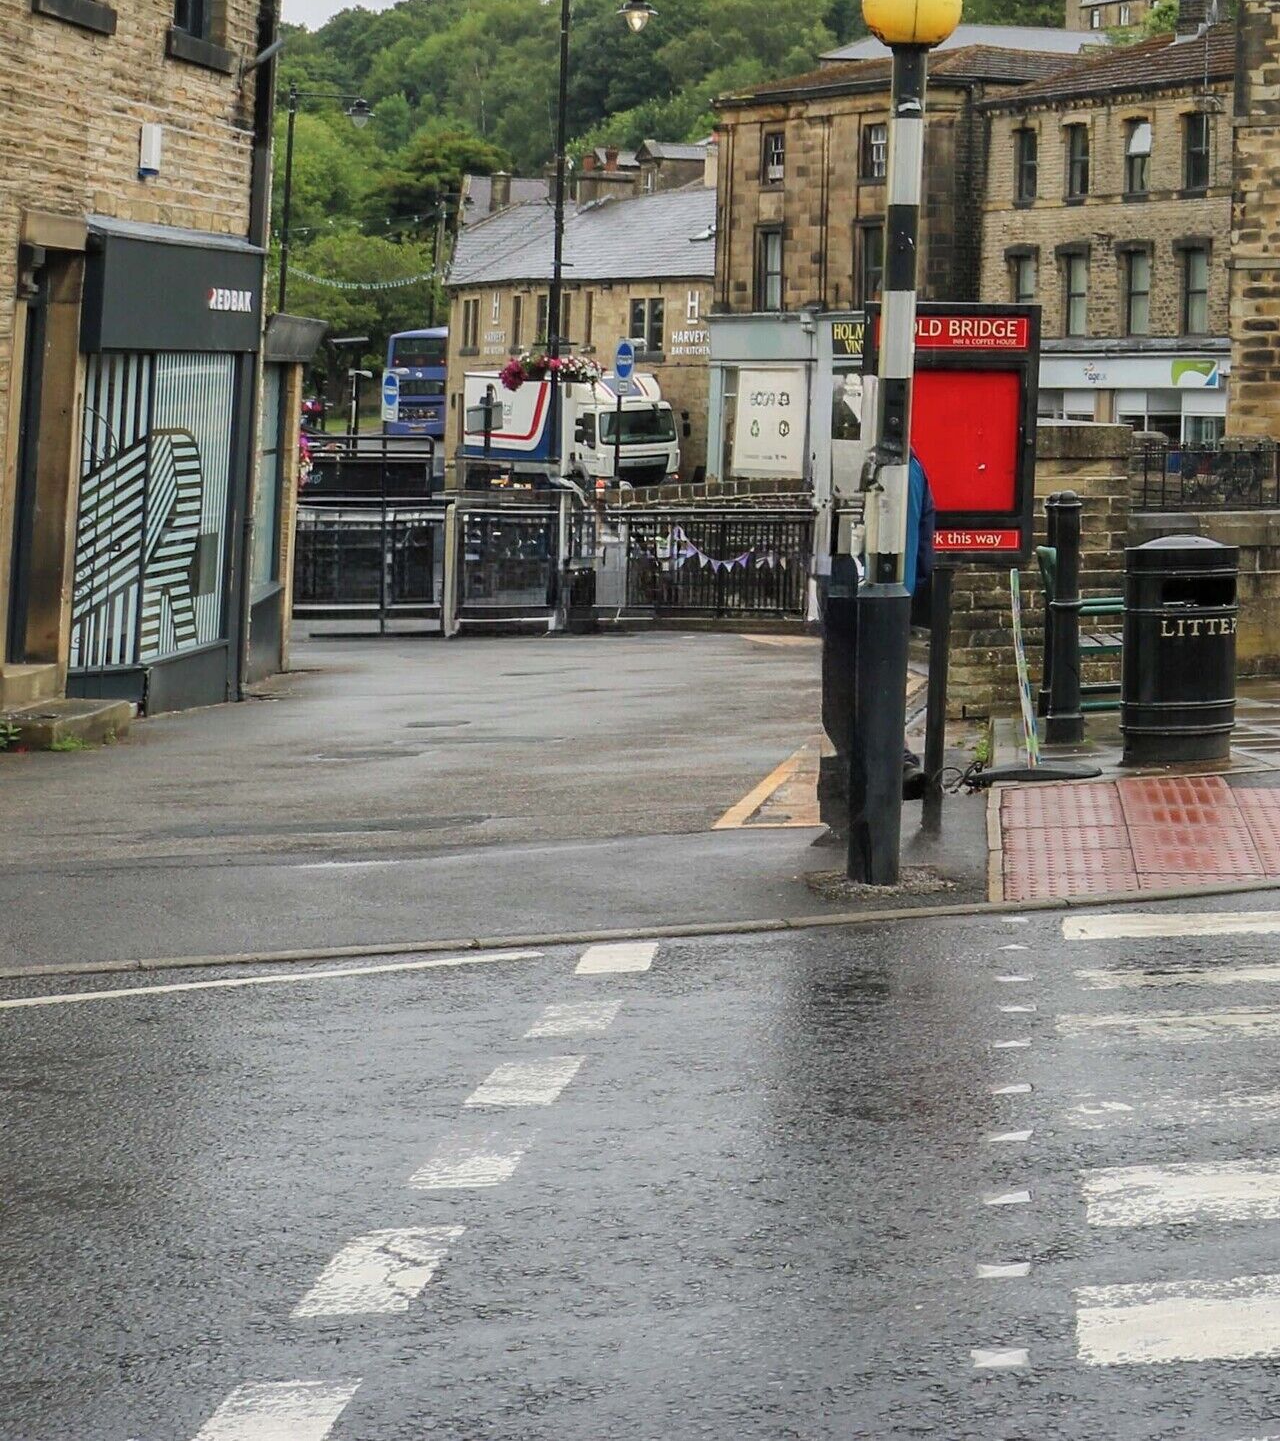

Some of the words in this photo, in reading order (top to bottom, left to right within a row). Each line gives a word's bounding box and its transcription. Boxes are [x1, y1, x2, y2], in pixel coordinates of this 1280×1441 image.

[914, 319, 942, 337] LD
[948, 319, 1018, 338] BRIDGE
[996, 338, 1017, 346] HOUSE
[947, 532, 972, 544] this
[975, 534, 1002, 547] way
